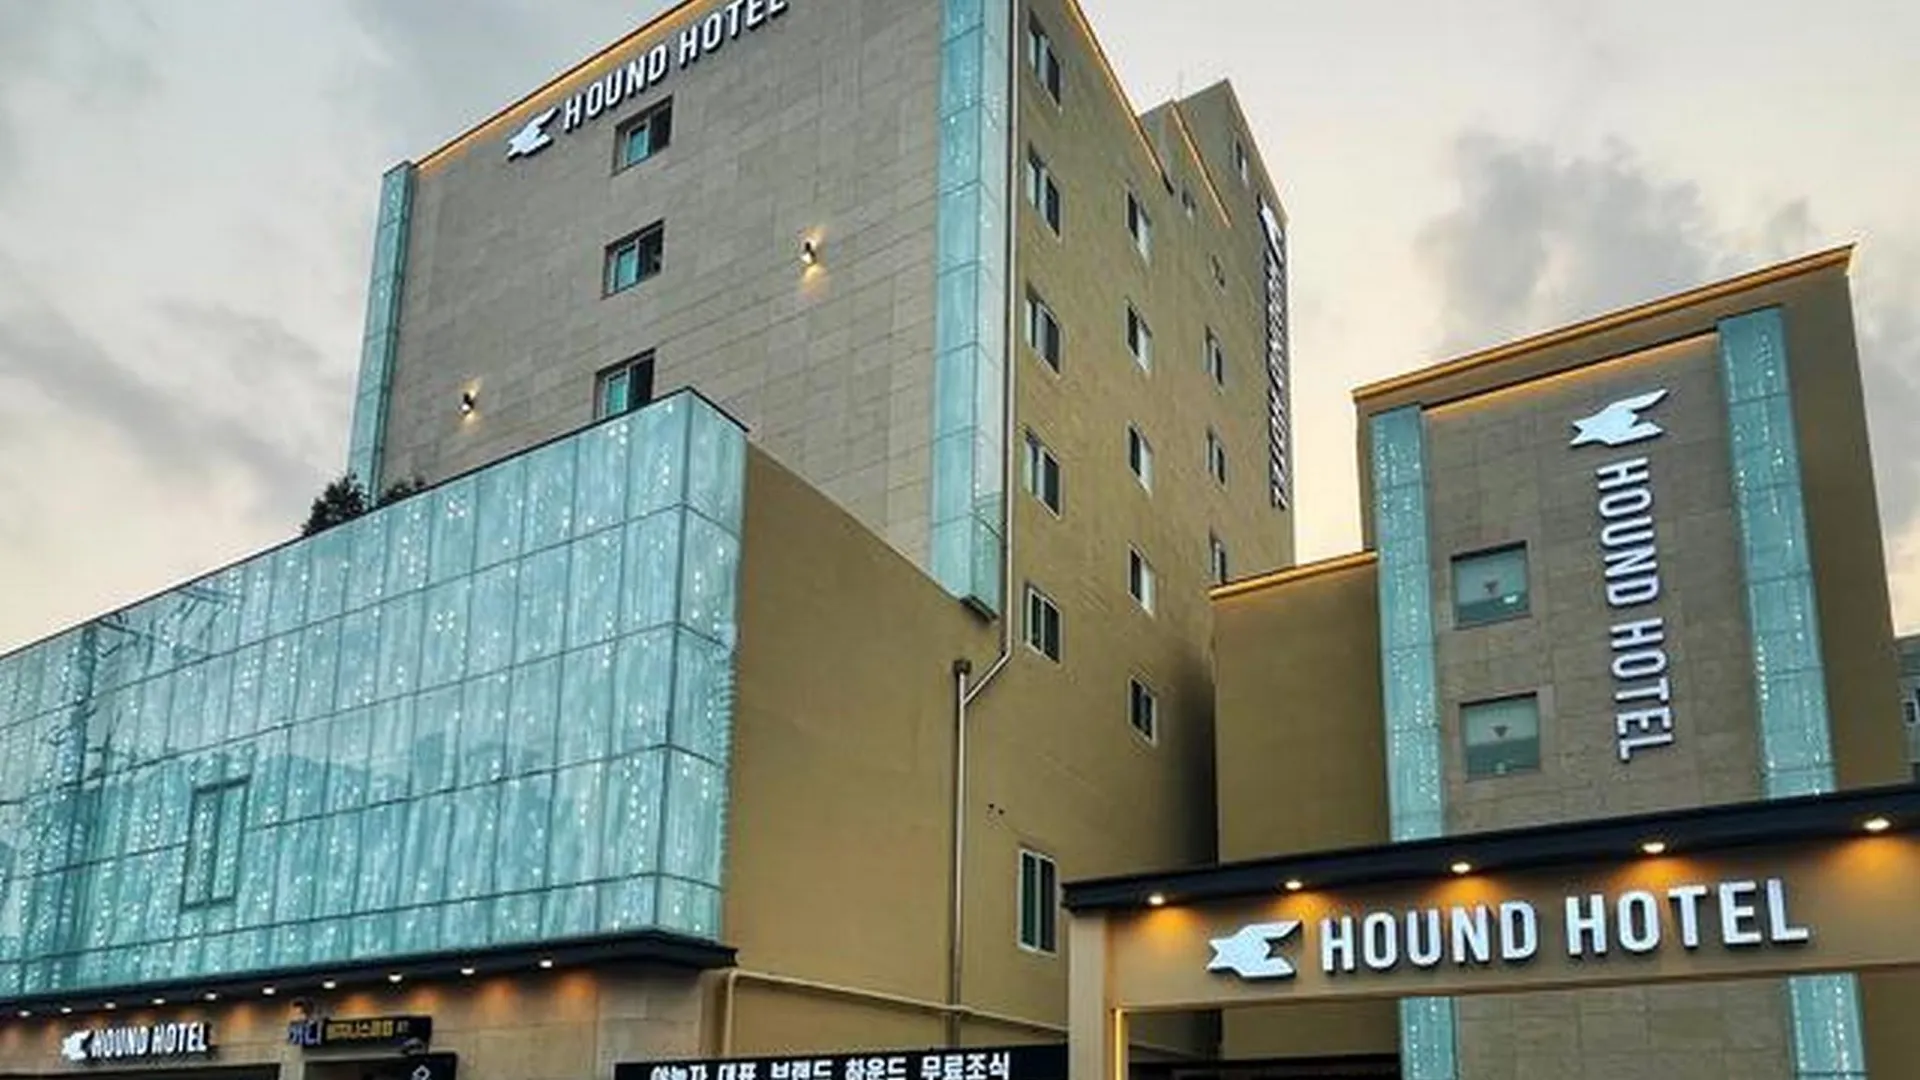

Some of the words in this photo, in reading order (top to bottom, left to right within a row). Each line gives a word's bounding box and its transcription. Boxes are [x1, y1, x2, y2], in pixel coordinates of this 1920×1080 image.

[563, 44, 670, 133] HOUND
[678, 0, 789, 68] HOTEL
[1596, 457, 1660, 608] HOUND
[1609, 617, 1677, 763] HOTEL
[1319, 898, 1539, 973] HOUND
[1565, 878, 1810, 957] HOTEL
[91, 1026, 149, 1057] HOUND
[151, 1021, 207, 1054] HOTEL
[845, 1055, 908, 1080] 하운드
[919, 1050, 1011, 1080] 무료조식
